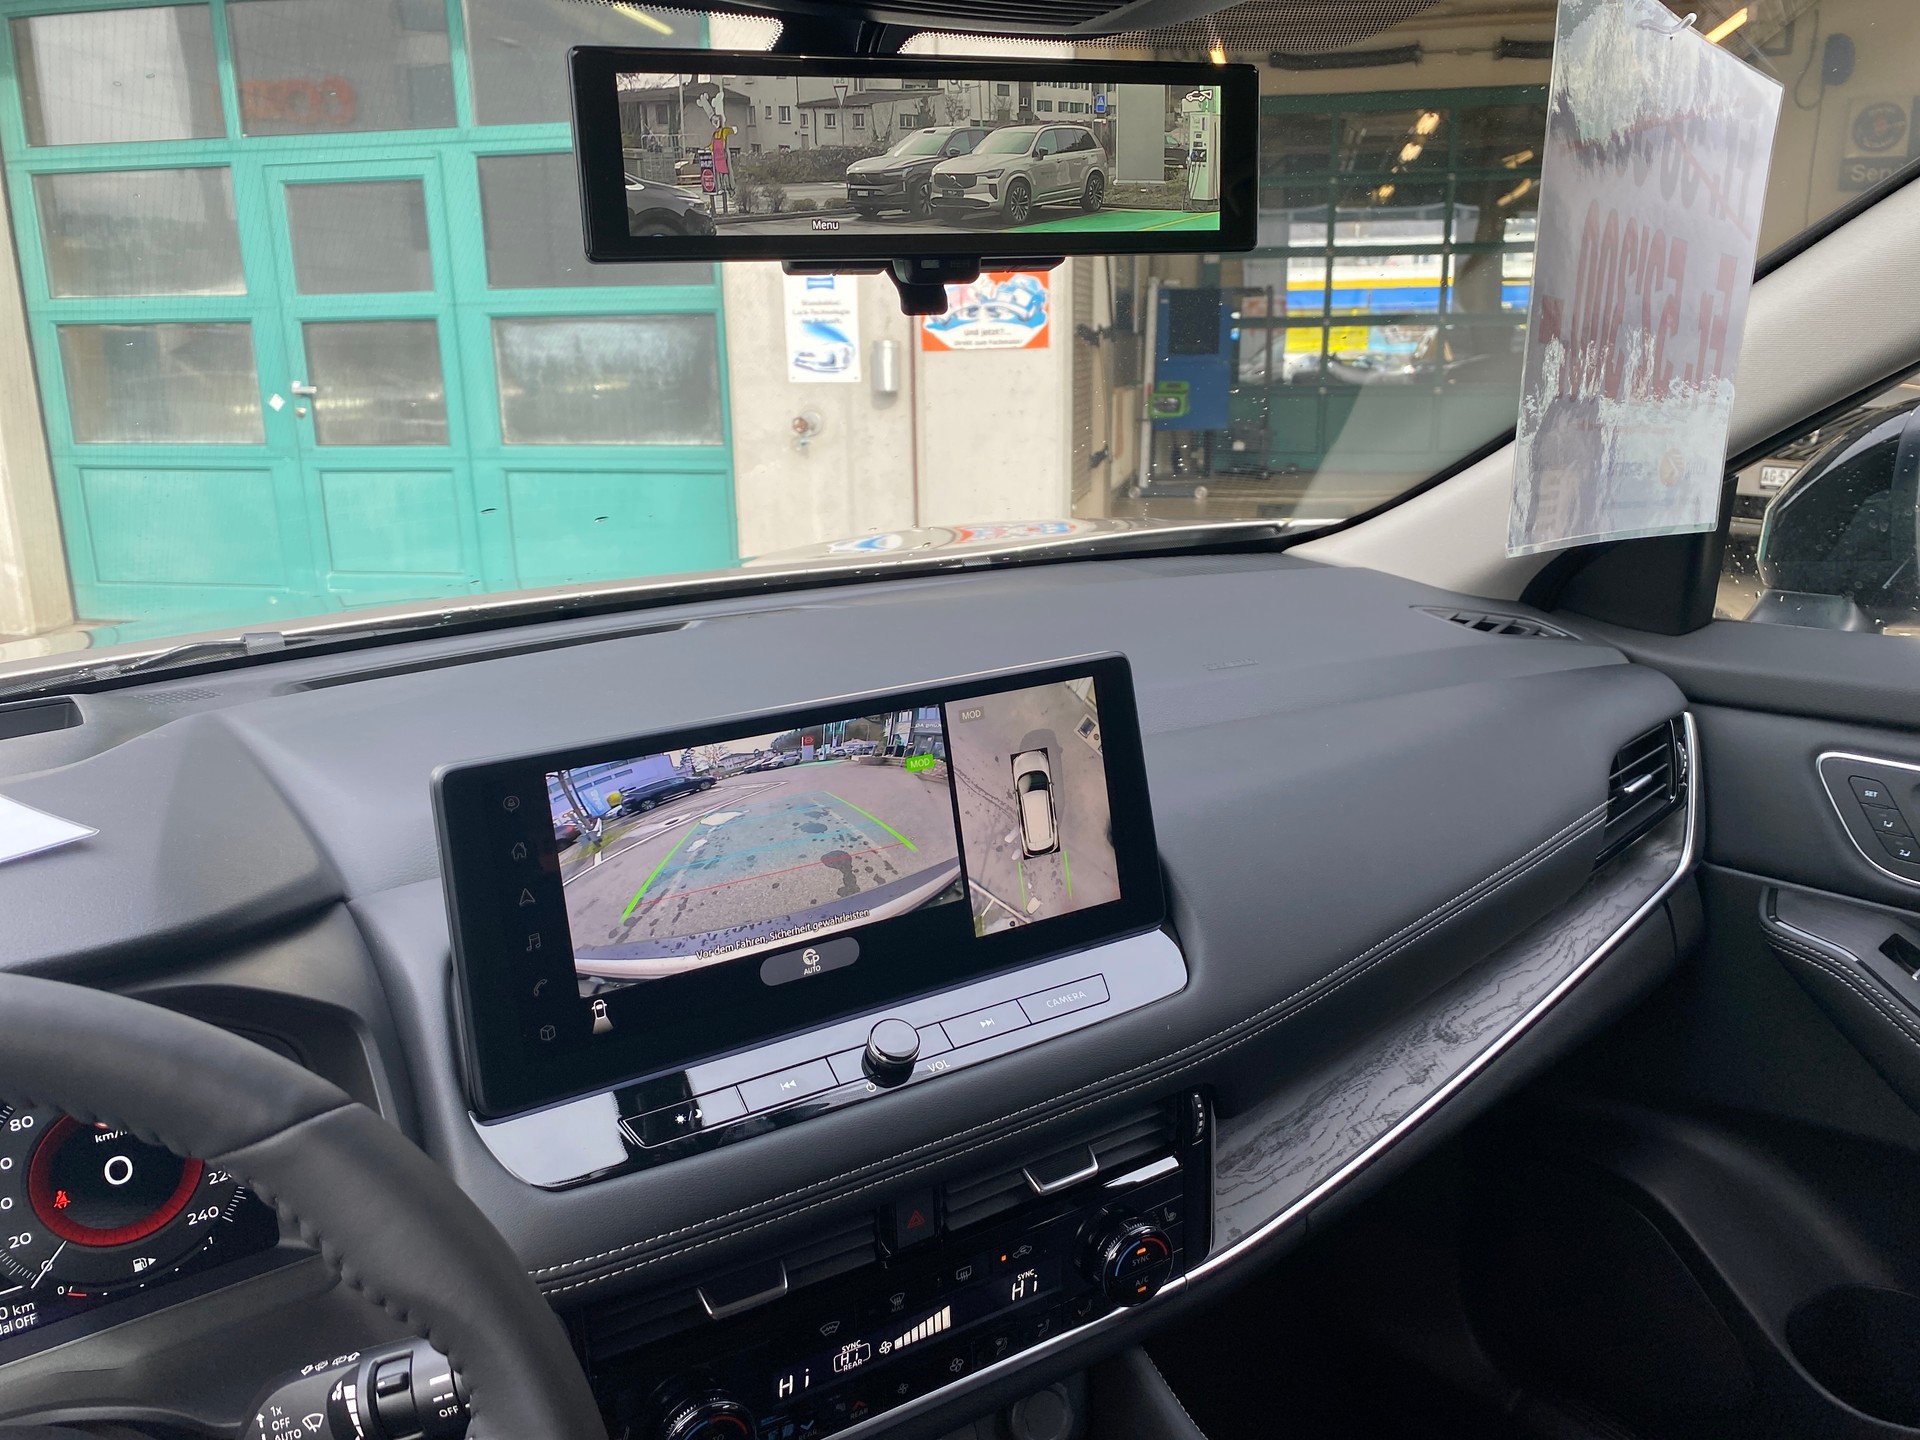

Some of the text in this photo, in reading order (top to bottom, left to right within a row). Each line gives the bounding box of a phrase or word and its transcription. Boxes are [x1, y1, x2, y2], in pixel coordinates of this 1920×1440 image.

[812, 220, 839, 230] Menu
[961, 709, 981, 720] MOD
[910, 757, 930, 769] MOD
[1864, 790, 1879, 798] SET
[695, 909, 870, 960] Vor dem Fahren, Sicherheit gewährleisten
[803, 965, 821, 976] AUTO
[1046, 991, 1087, 1008] CAMERA
[927, 1060, 951, 1073] VOL
[9, 1115, 34, 1132] 80
[94, 1129, 128, 1143] km/
[104, 1155, 133, 1186] 0
[208, 1170, 233, 1185] 22
[187, 1206, 220, 1226] 240
[8, 1232, 32, 1249] 20
[208, 1236, 214, 1244] 1
[1132, 1253, 1151, 1267] SYNC
[1017, 1268, 1035, 1281] SYNC
[1135, 1276, 1149, 1287] A/C
[57, 1286, 65, 1295] 0
[12, 1302, 35, 1316] km
[15, 1313, 37, 1330] OFF
[841, 1339, 861, 1353] SYNC
[843, 1359, 863, 1372] REAR
[270, 1406, 282, 1417] 1x
[439, 1405, 459, 1418] OFF
[271, 1417, 291, 1431] OFF
[275, 1428, 302, 1440] AUTO
